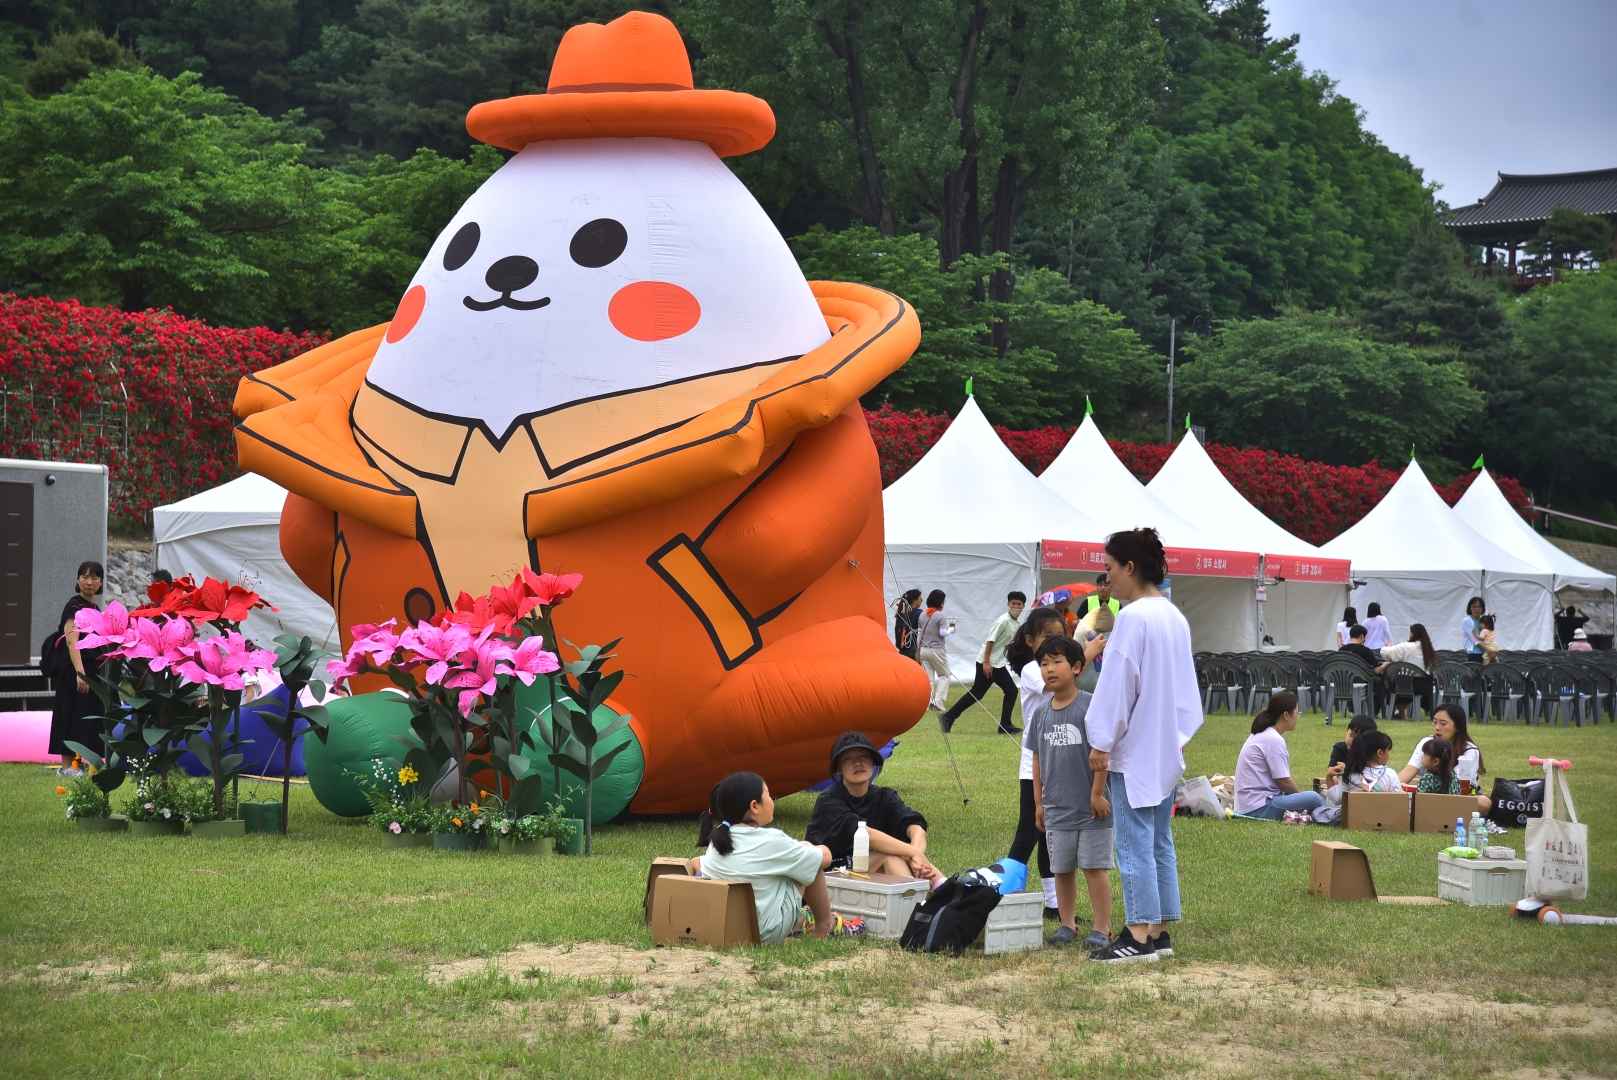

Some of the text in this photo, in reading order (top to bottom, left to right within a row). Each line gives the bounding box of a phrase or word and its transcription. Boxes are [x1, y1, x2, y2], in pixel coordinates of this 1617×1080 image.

[1052, 724, 1066, 732] THE
[1044, 732, 1067, 740] NORTH
[1498, 799, 1545, 812] EGOIS
